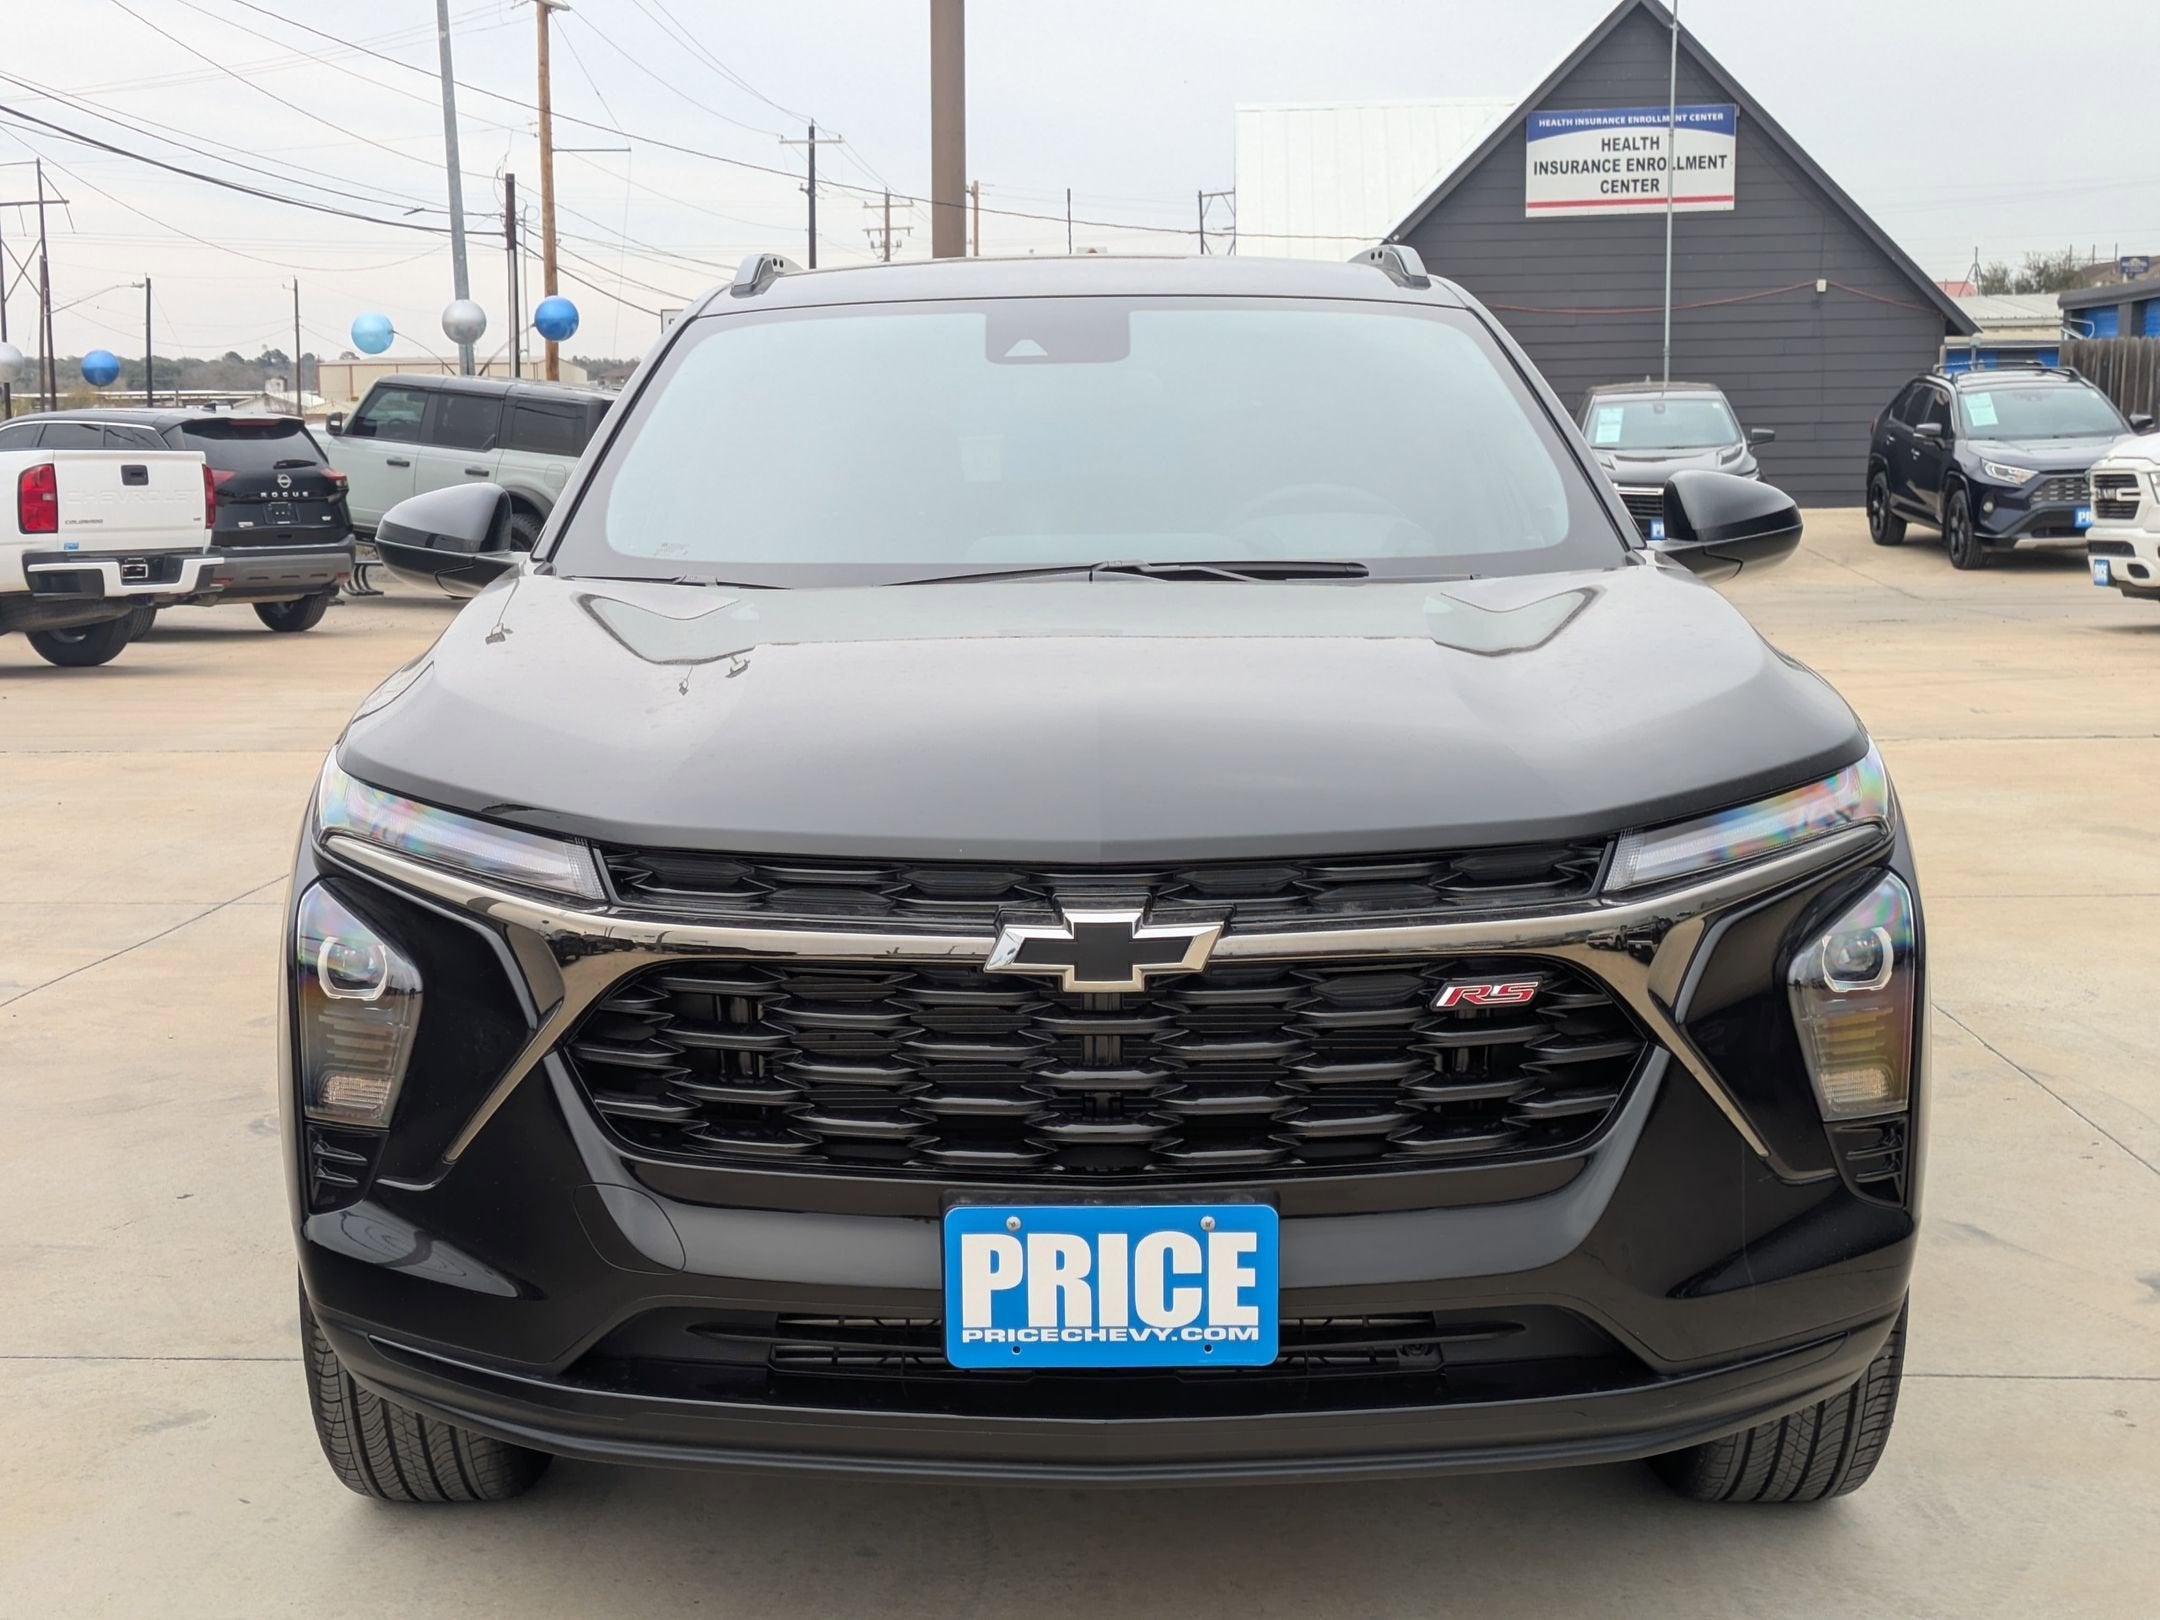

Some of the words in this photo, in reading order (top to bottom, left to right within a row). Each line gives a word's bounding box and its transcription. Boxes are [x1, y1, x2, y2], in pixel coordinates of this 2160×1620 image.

[1538, 119, 1573, 127] HEALTH
[1575, 116, 1626, 126] INSURANCE
[1628, 114, 1687, 124] ENROLLMNT
[1689, 112, 1724, 122] CENTER
[1601, 136, 1660, 152] HEALTH
[1533, 158, 1621, 176] INSURANCE
[1600, 178, 1660, 194] CENTER
[1436, 981, 1539, 1007] RS
[961, 1231, 1259, 1328] PRICE
[962, 1327, 1259, 1343] PRICECHEVY.COM
